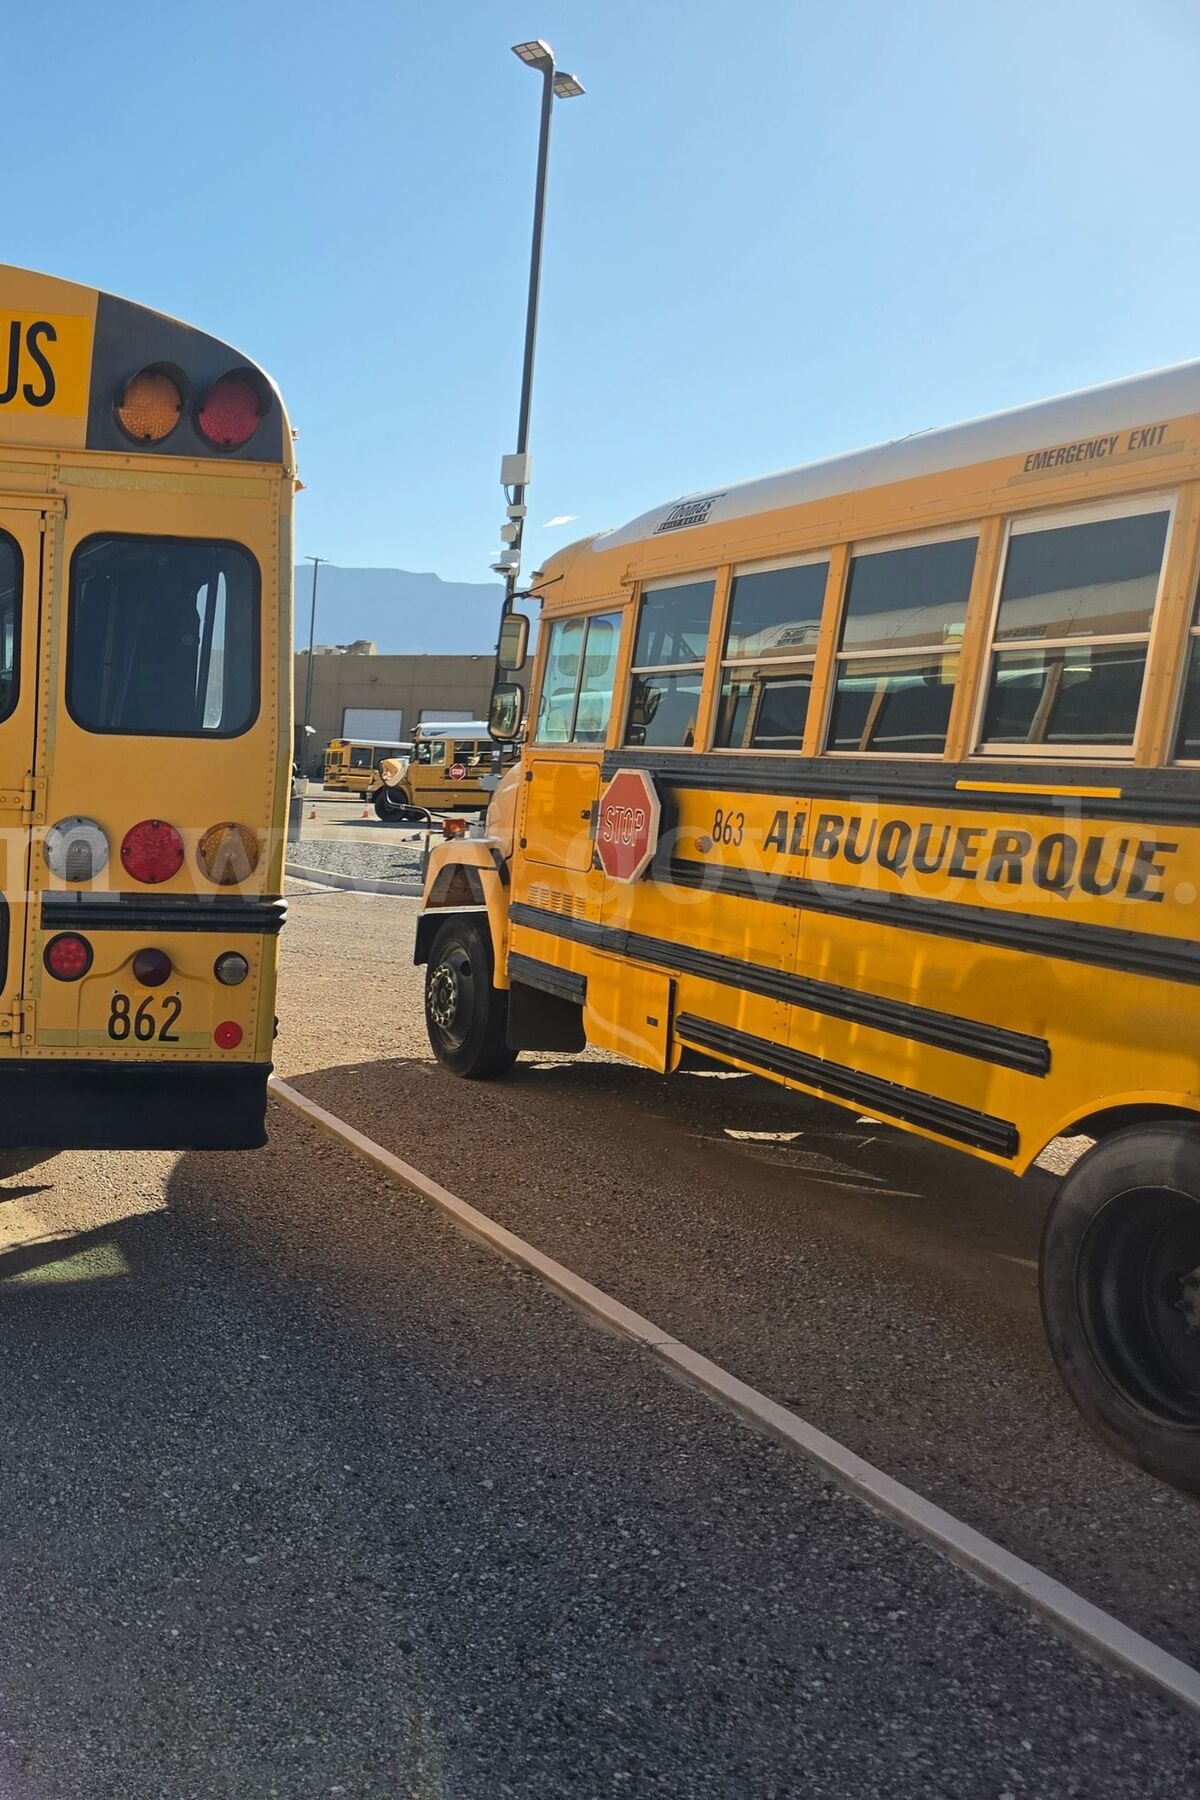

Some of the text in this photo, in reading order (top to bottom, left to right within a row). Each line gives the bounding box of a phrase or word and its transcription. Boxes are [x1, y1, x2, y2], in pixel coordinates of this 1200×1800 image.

[1023, 424, 1168, 472] EMERGENCY EXIT
[603, 805, 645, 847] STOP
[712, 808, 1178, 903] 863 ALBUQUERQUE
[108, 994, 182, 1042] 862
